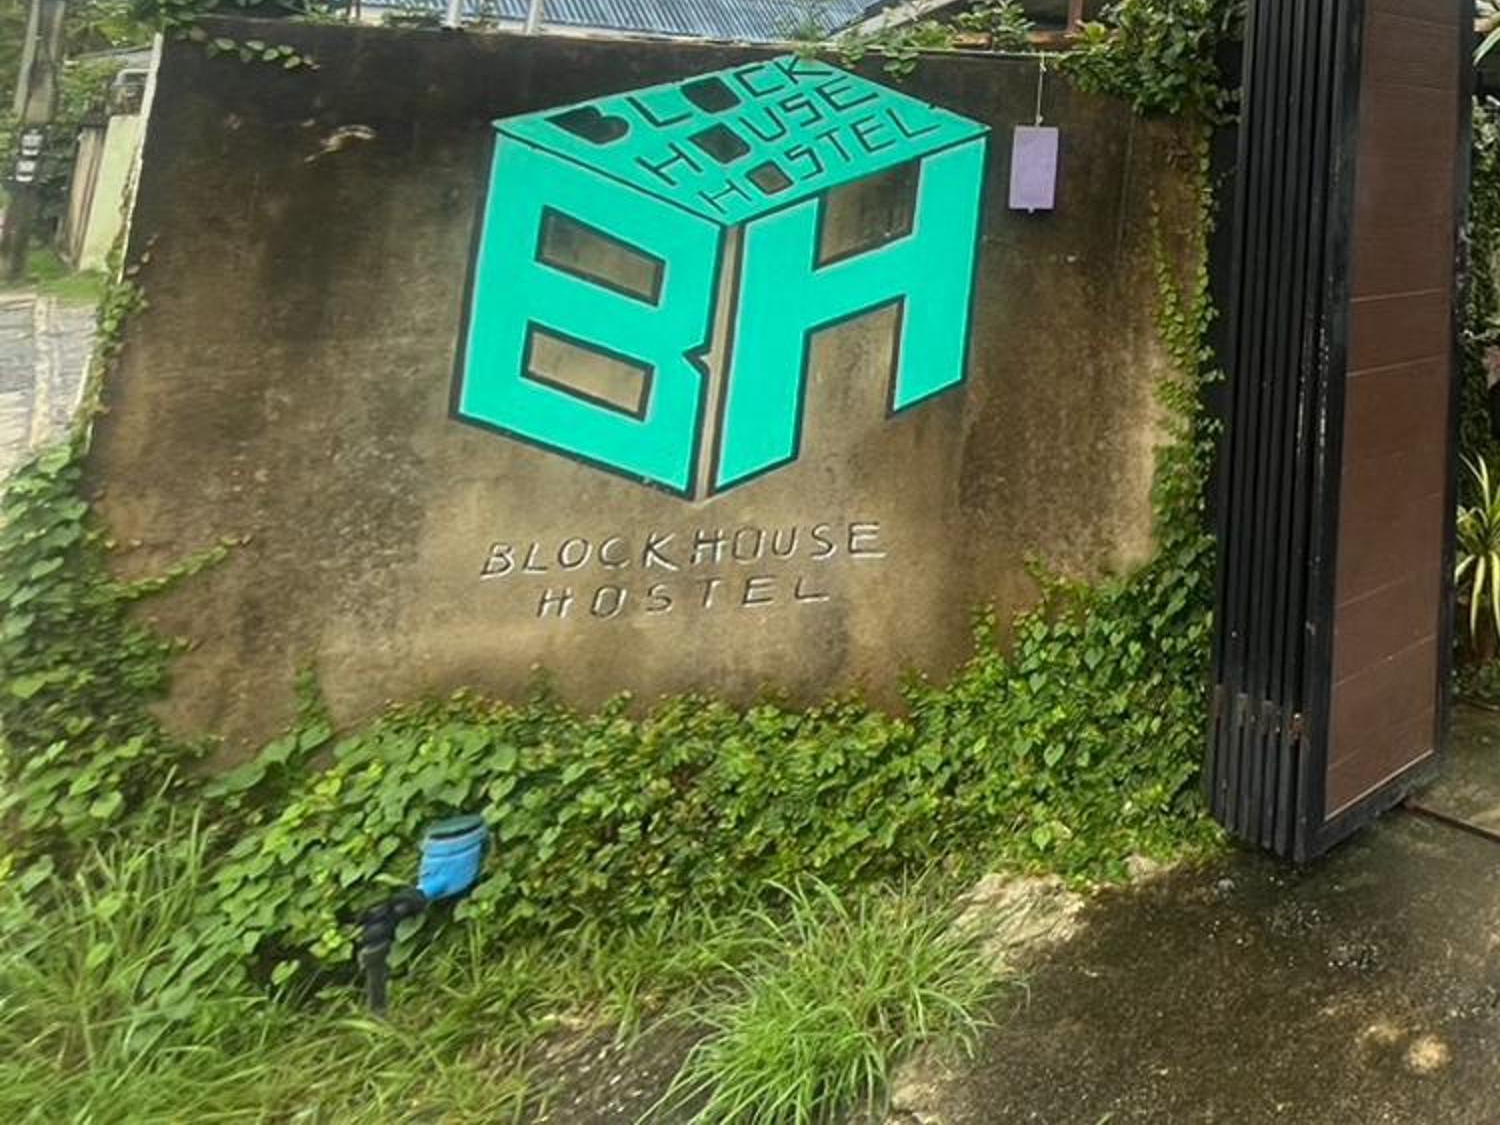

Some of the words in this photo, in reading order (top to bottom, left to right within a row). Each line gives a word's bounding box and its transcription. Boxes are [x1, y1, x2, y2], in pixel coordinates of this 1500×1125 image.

[544, 53, 834, 145] BLOCK
[634, 78, 880, 186] HOUSE
[697, 108, 941, 215] HOSTEL
[480, 520, 888, 580] BLOCKHOUSE
[534, 575, 832, 620] HOSTEL
